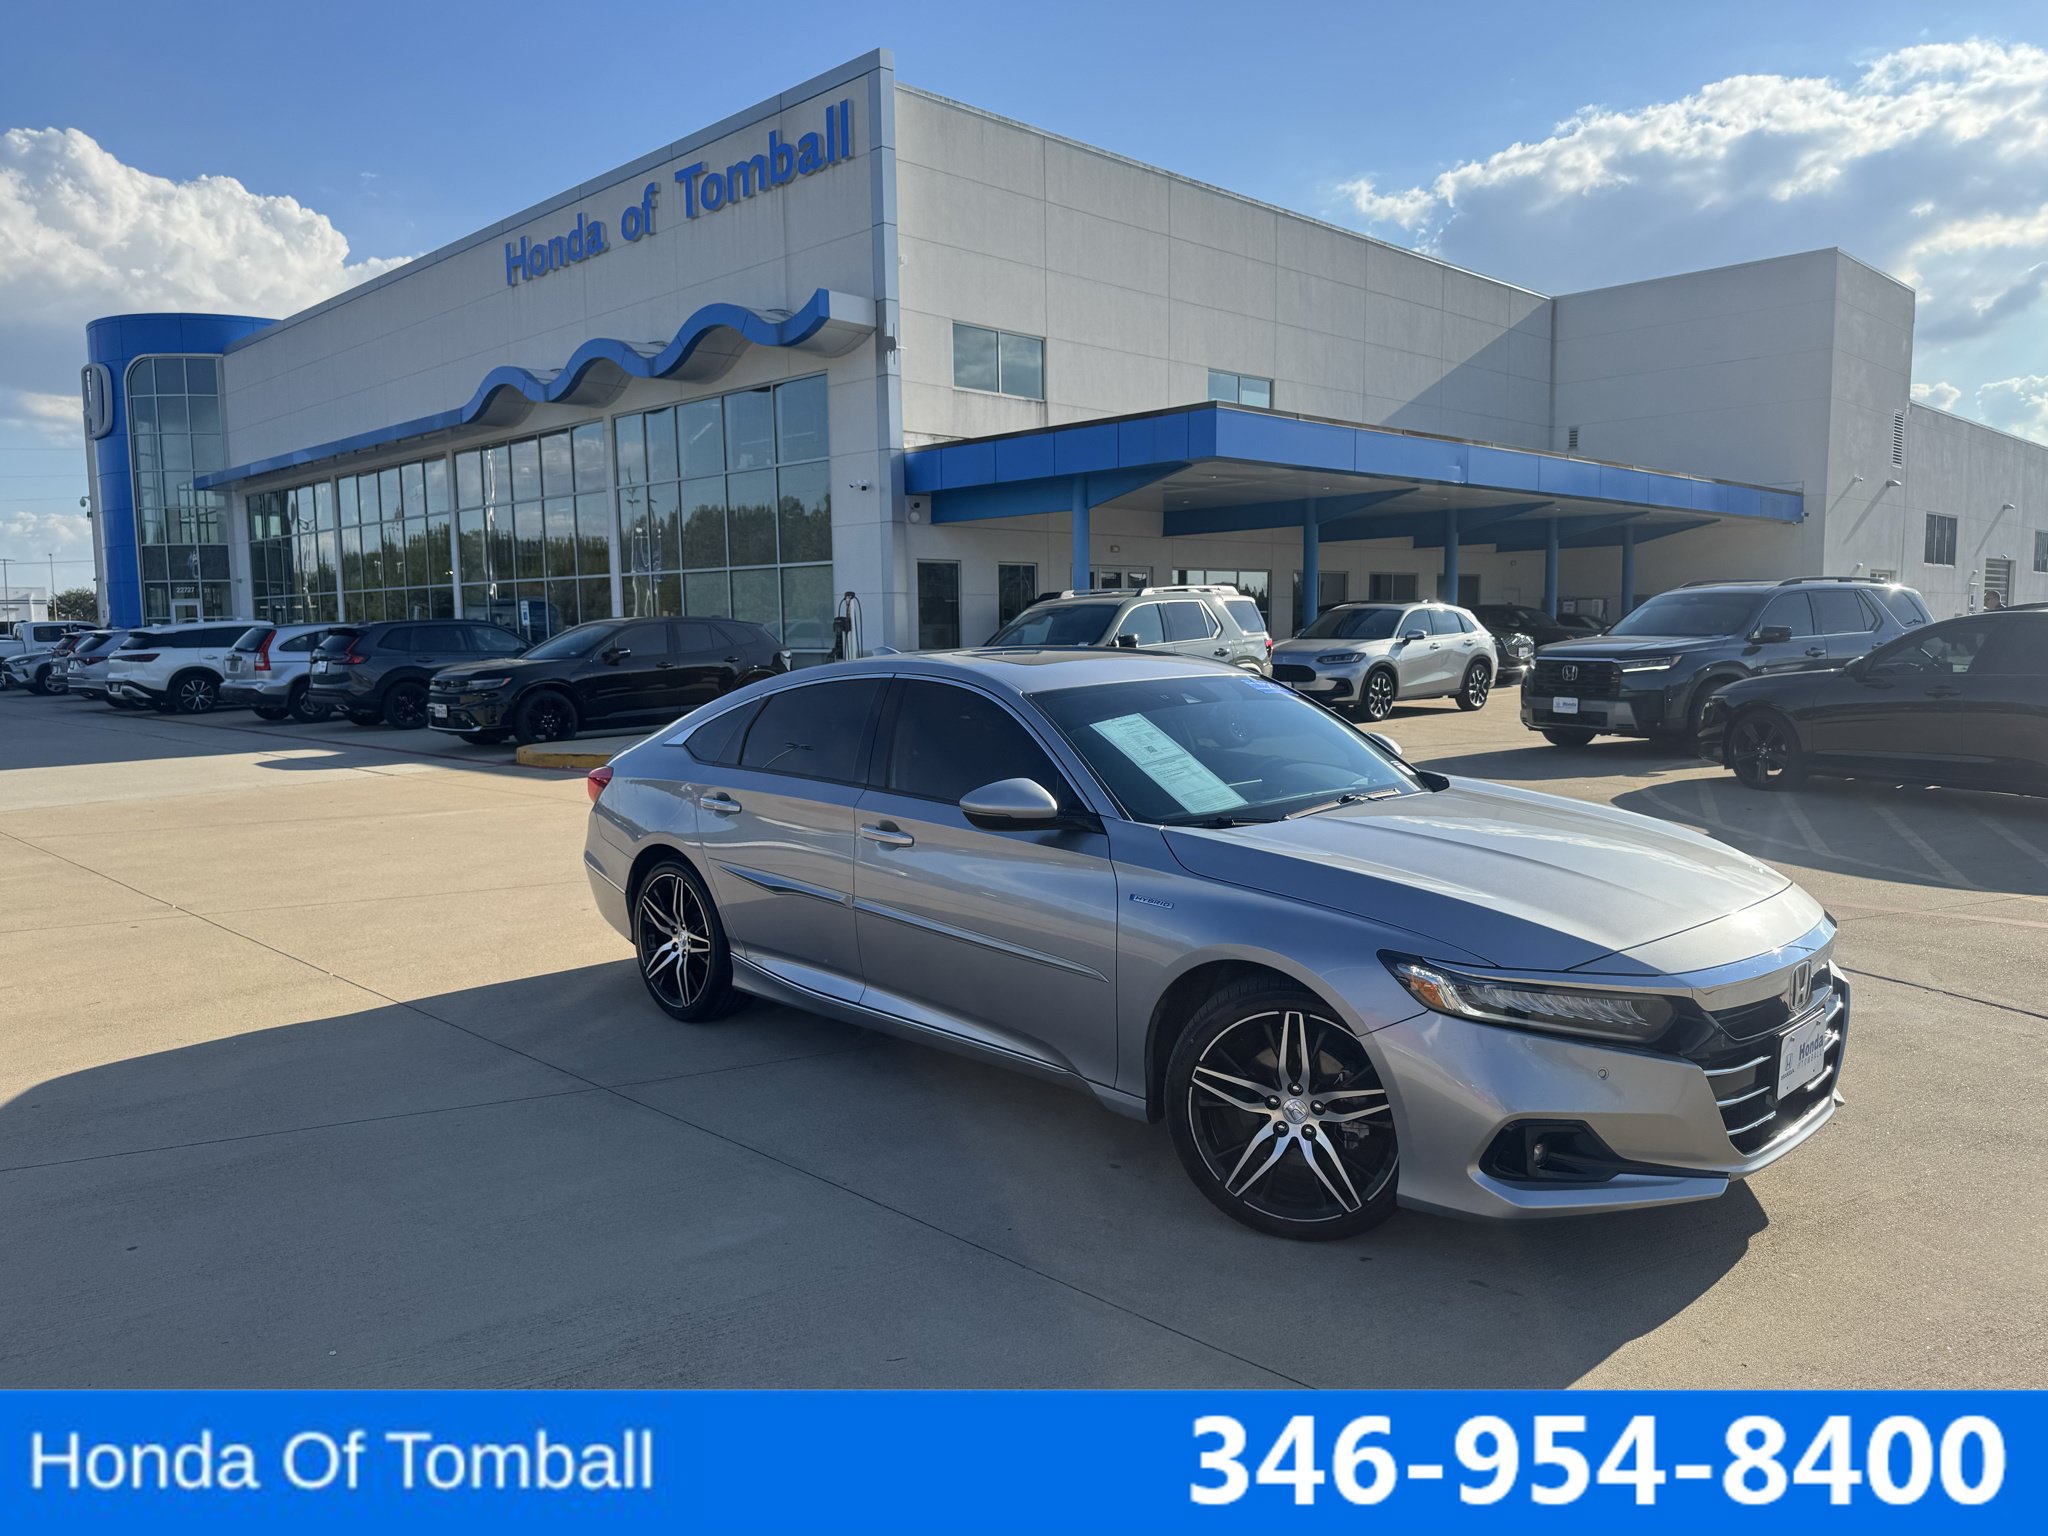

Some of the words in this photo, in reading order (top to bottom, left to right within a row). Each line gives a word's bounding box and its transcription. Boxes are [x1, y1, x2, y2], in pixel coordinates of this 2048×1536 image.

[505, 212, 607, 286] Honda
[621, 182, 658, 242] of
[675, 99, 853, 219] Tomball
[1133, 895, 1171, 908] HYBRID
[1799, 1033, 1824, 1061] Honda
